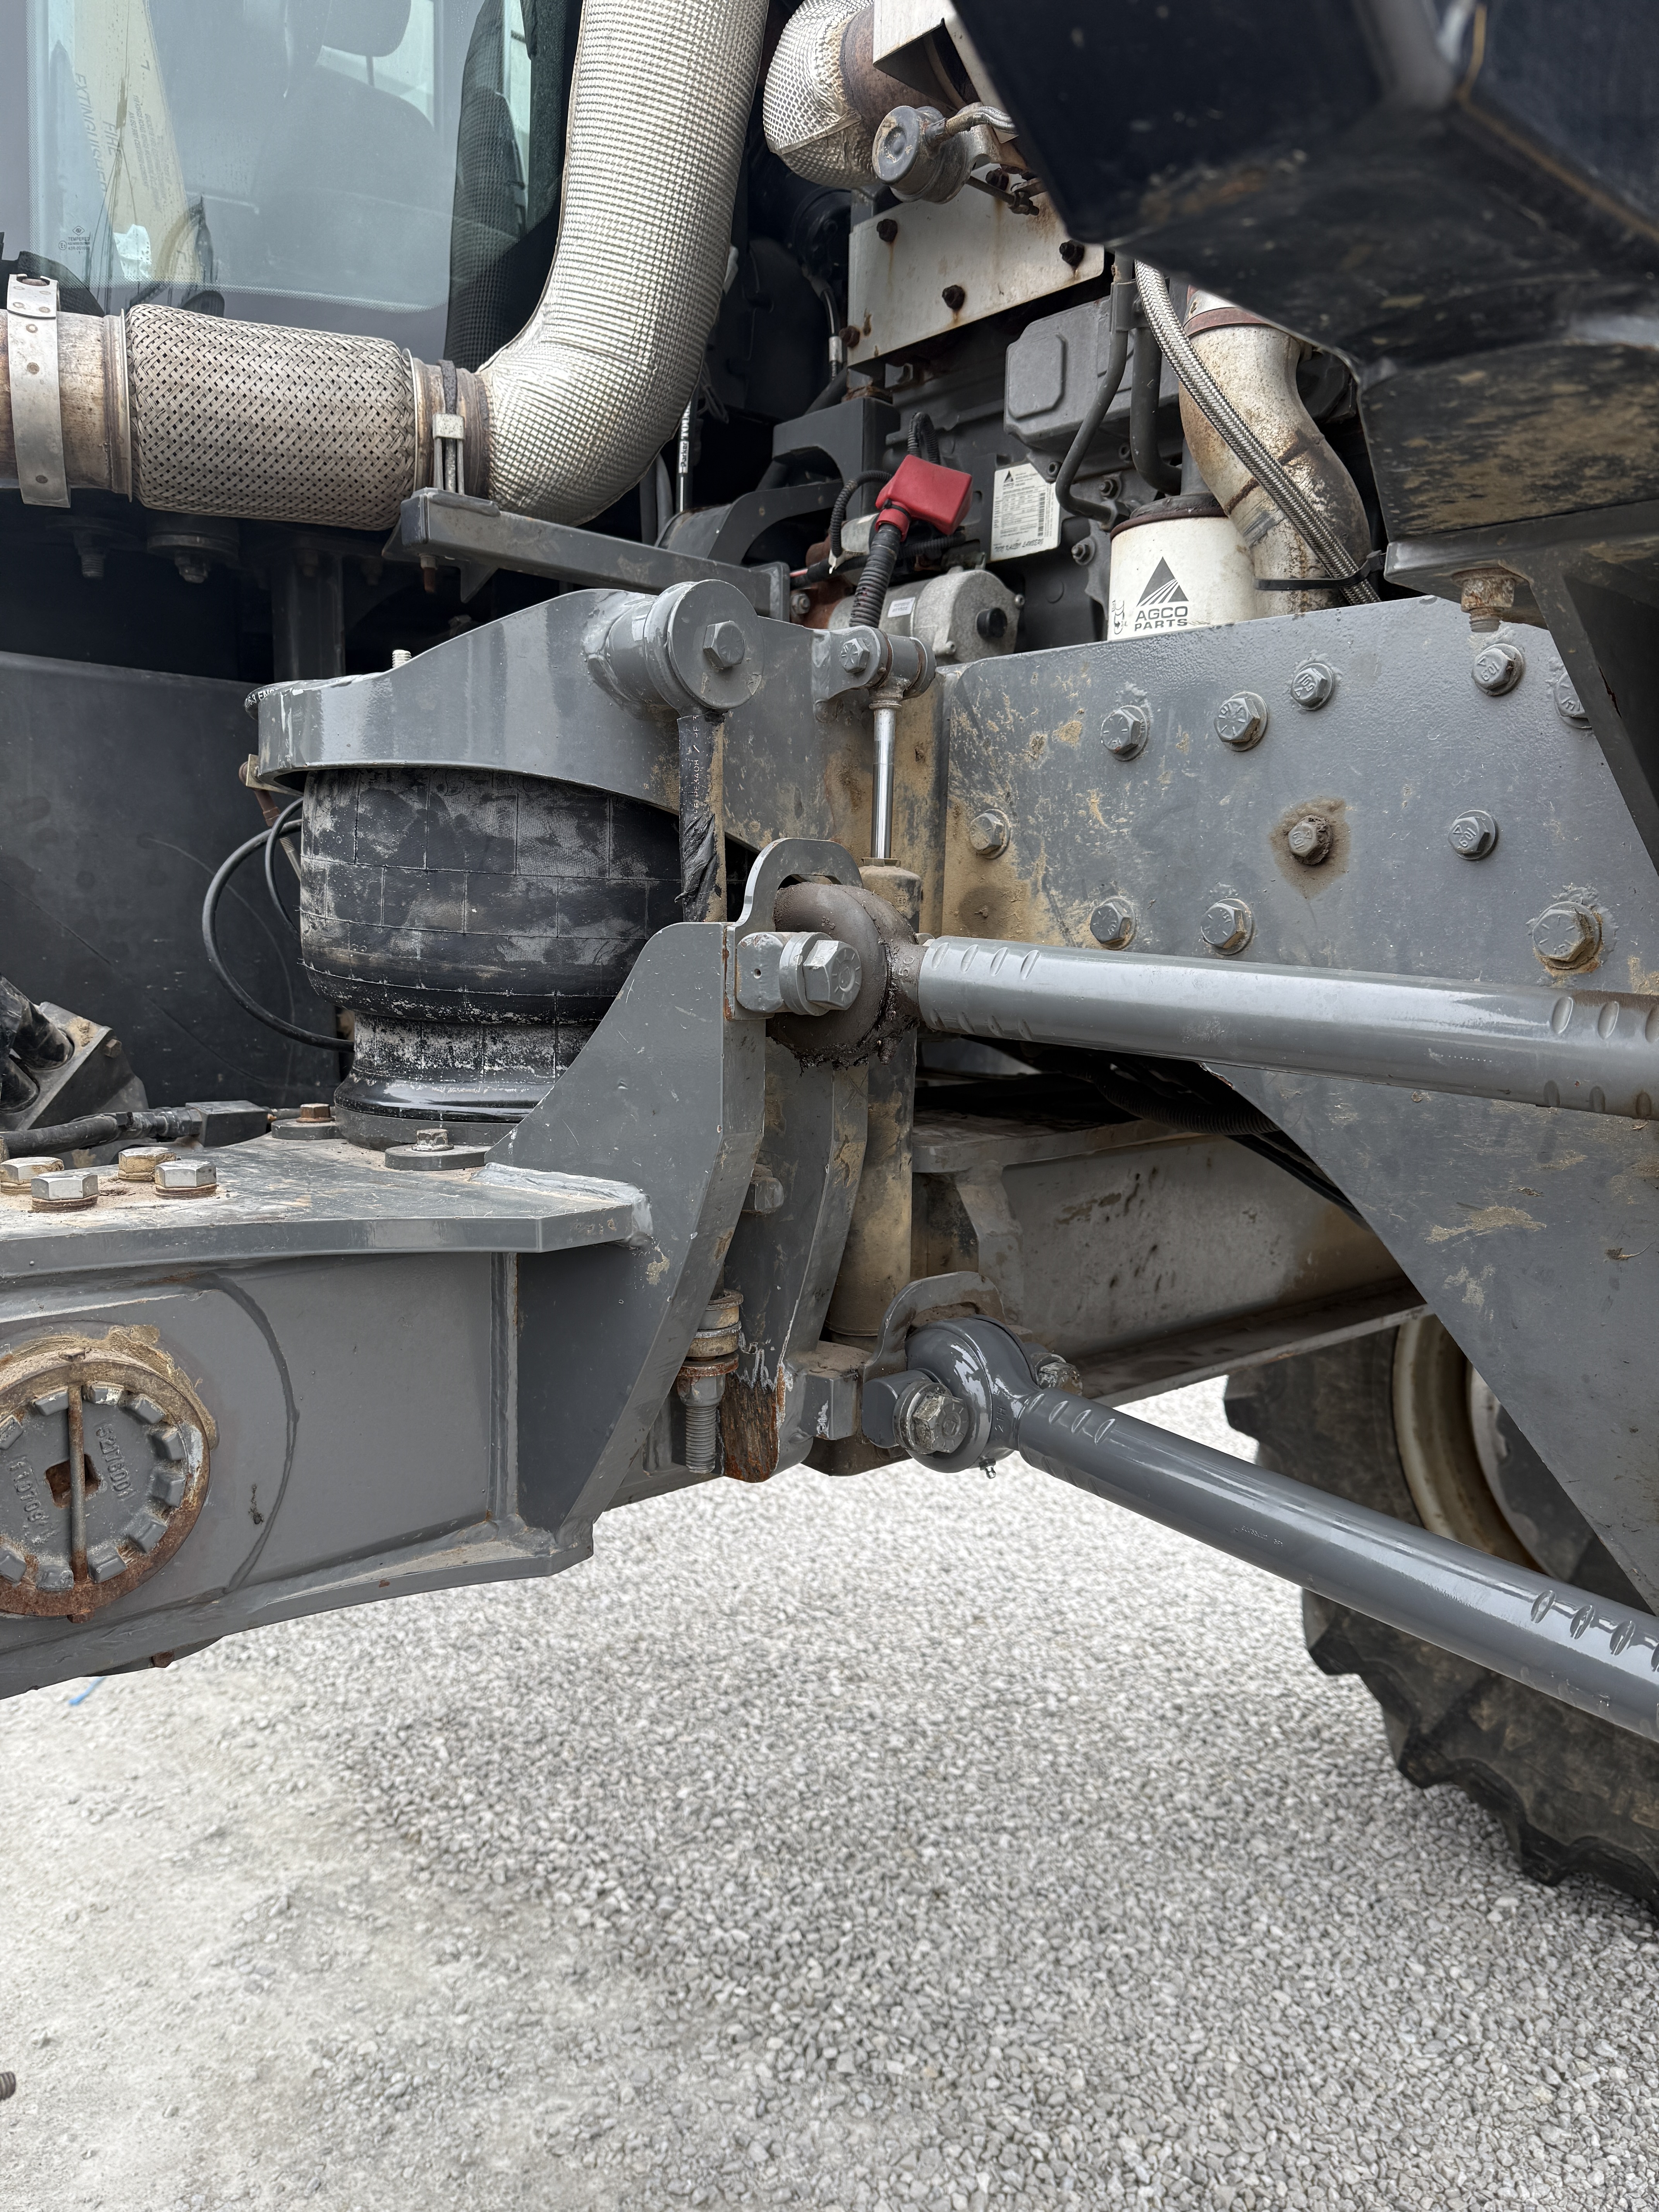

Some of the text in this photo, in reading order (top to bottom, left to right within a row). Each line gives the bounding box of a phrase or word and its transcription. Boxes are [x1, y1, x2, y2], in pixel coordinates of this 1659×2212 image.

[1135, 606, 1188, 622] AGCO
[1135, 619, 1187, 632] PARTS
[994, 1406, 1006, 1432] 21H
